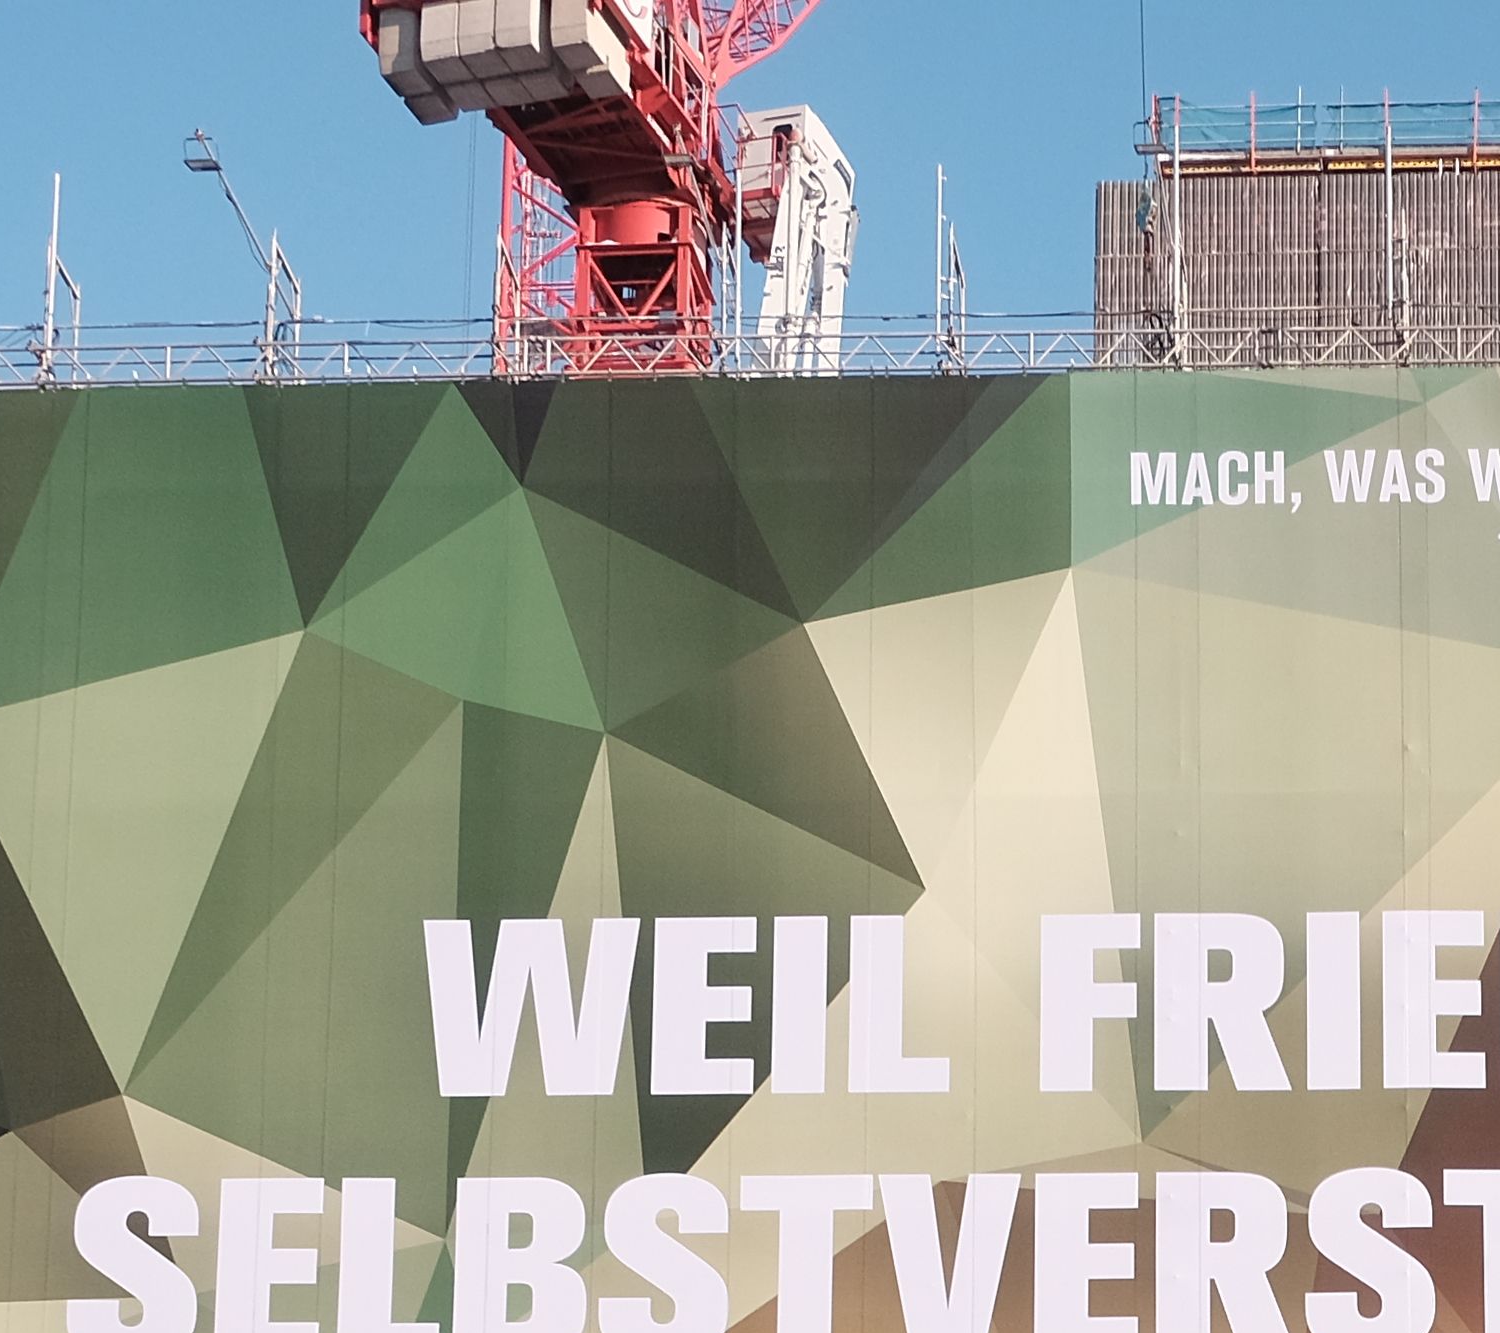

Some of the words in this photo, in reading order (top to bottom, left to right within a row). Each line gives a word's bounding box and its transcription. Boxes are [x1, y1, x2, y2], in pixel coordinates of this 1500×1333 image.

[1130, 450, 1302, 514] MACH,
[1323, 447, 1446, 504] WAS
[423, 913, 952, 1097] WEIL
